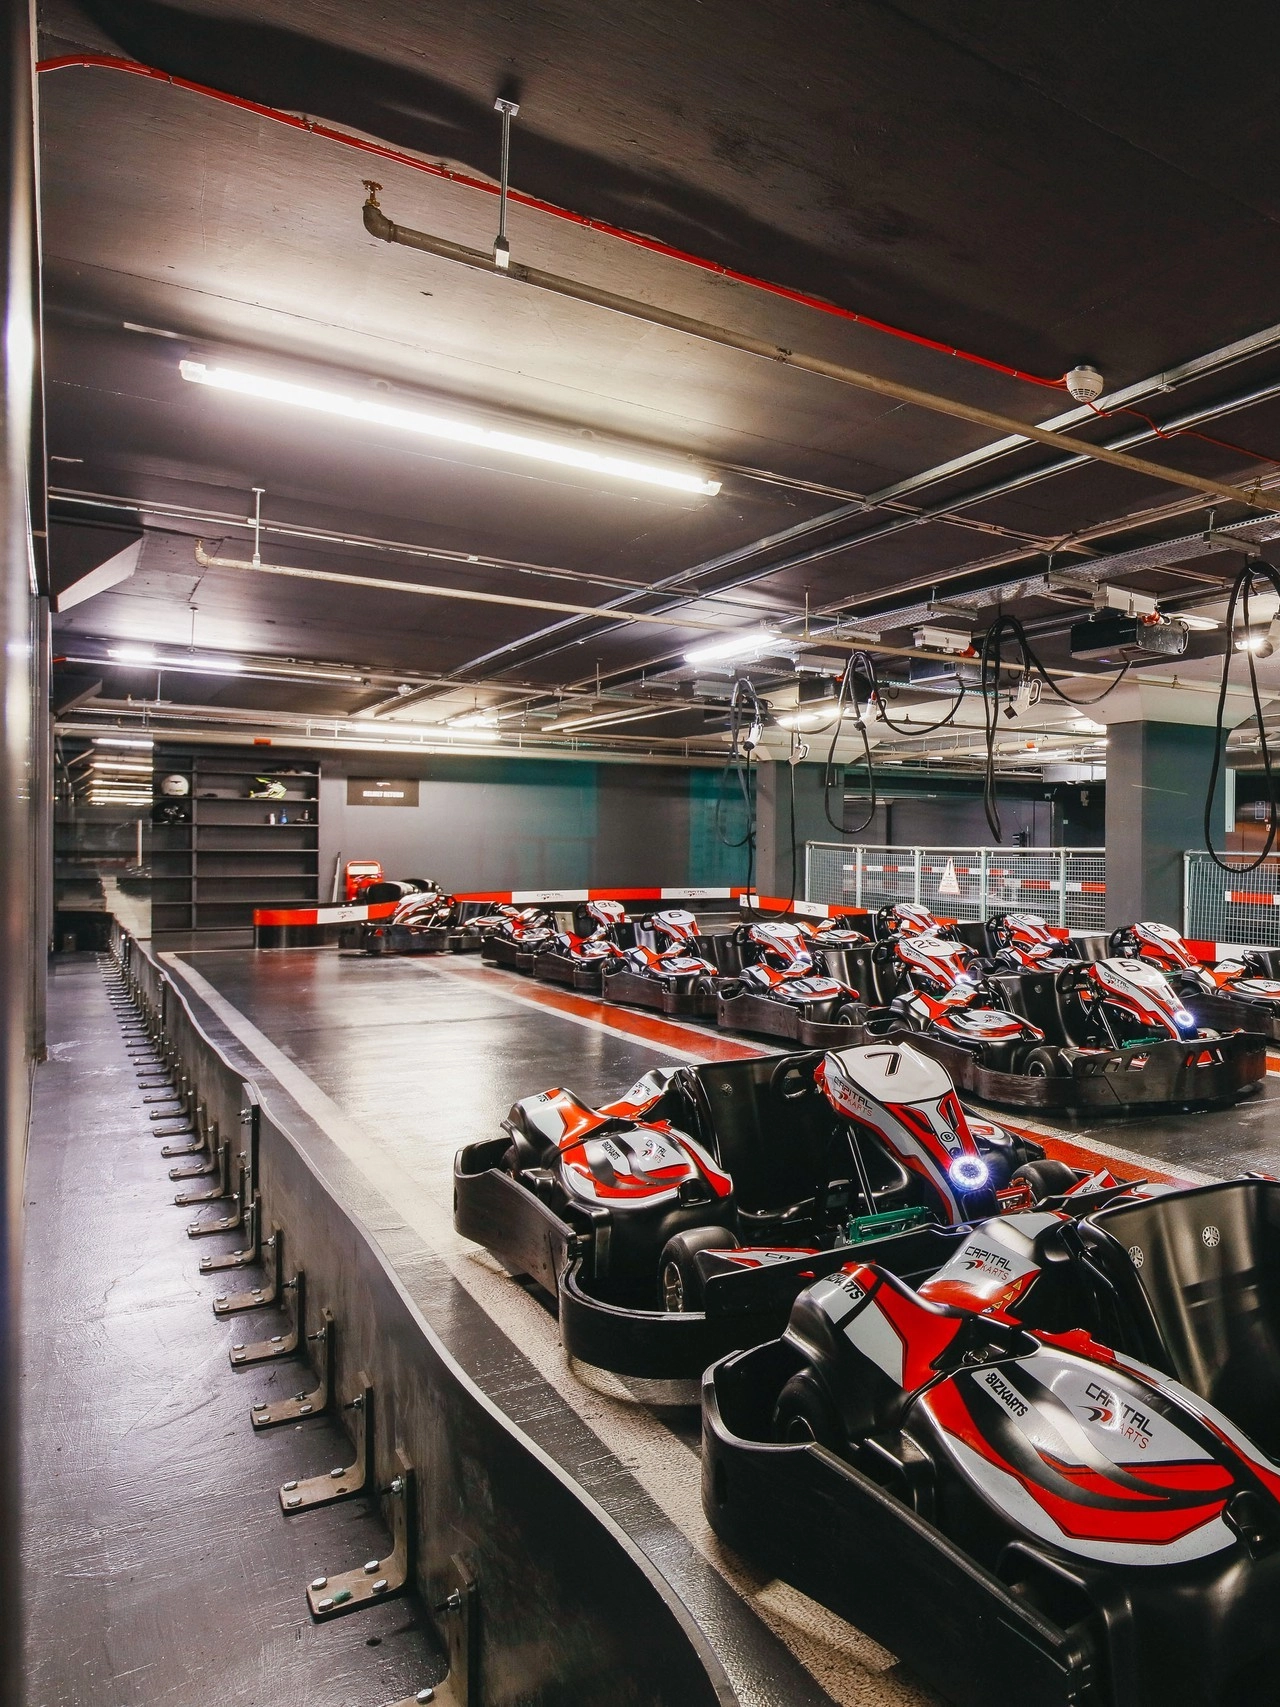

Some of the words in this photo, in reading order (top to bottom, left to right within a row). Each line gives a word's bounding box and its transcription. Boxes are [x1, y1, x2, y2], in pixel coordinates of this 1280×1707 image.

[1118, 961, 1141, 972] 5
[864, 1051, 902, 1077] 7
[833, 1075, 873, 1110] CAPITAL
[847, 1099, 873, 1117] KARTS
[645, 1139, 667, 1158] CATAL
[964, 1246, 1012, 1272] CAPITAL
[981, 1264, 1009, 1281] KARTS
[985, 1372, 1029, 1417] BIZKARTS
[1085, 1382, 1153, 1437] CAPTAL
[1108, 1417, 1149, 1450] ARTS
